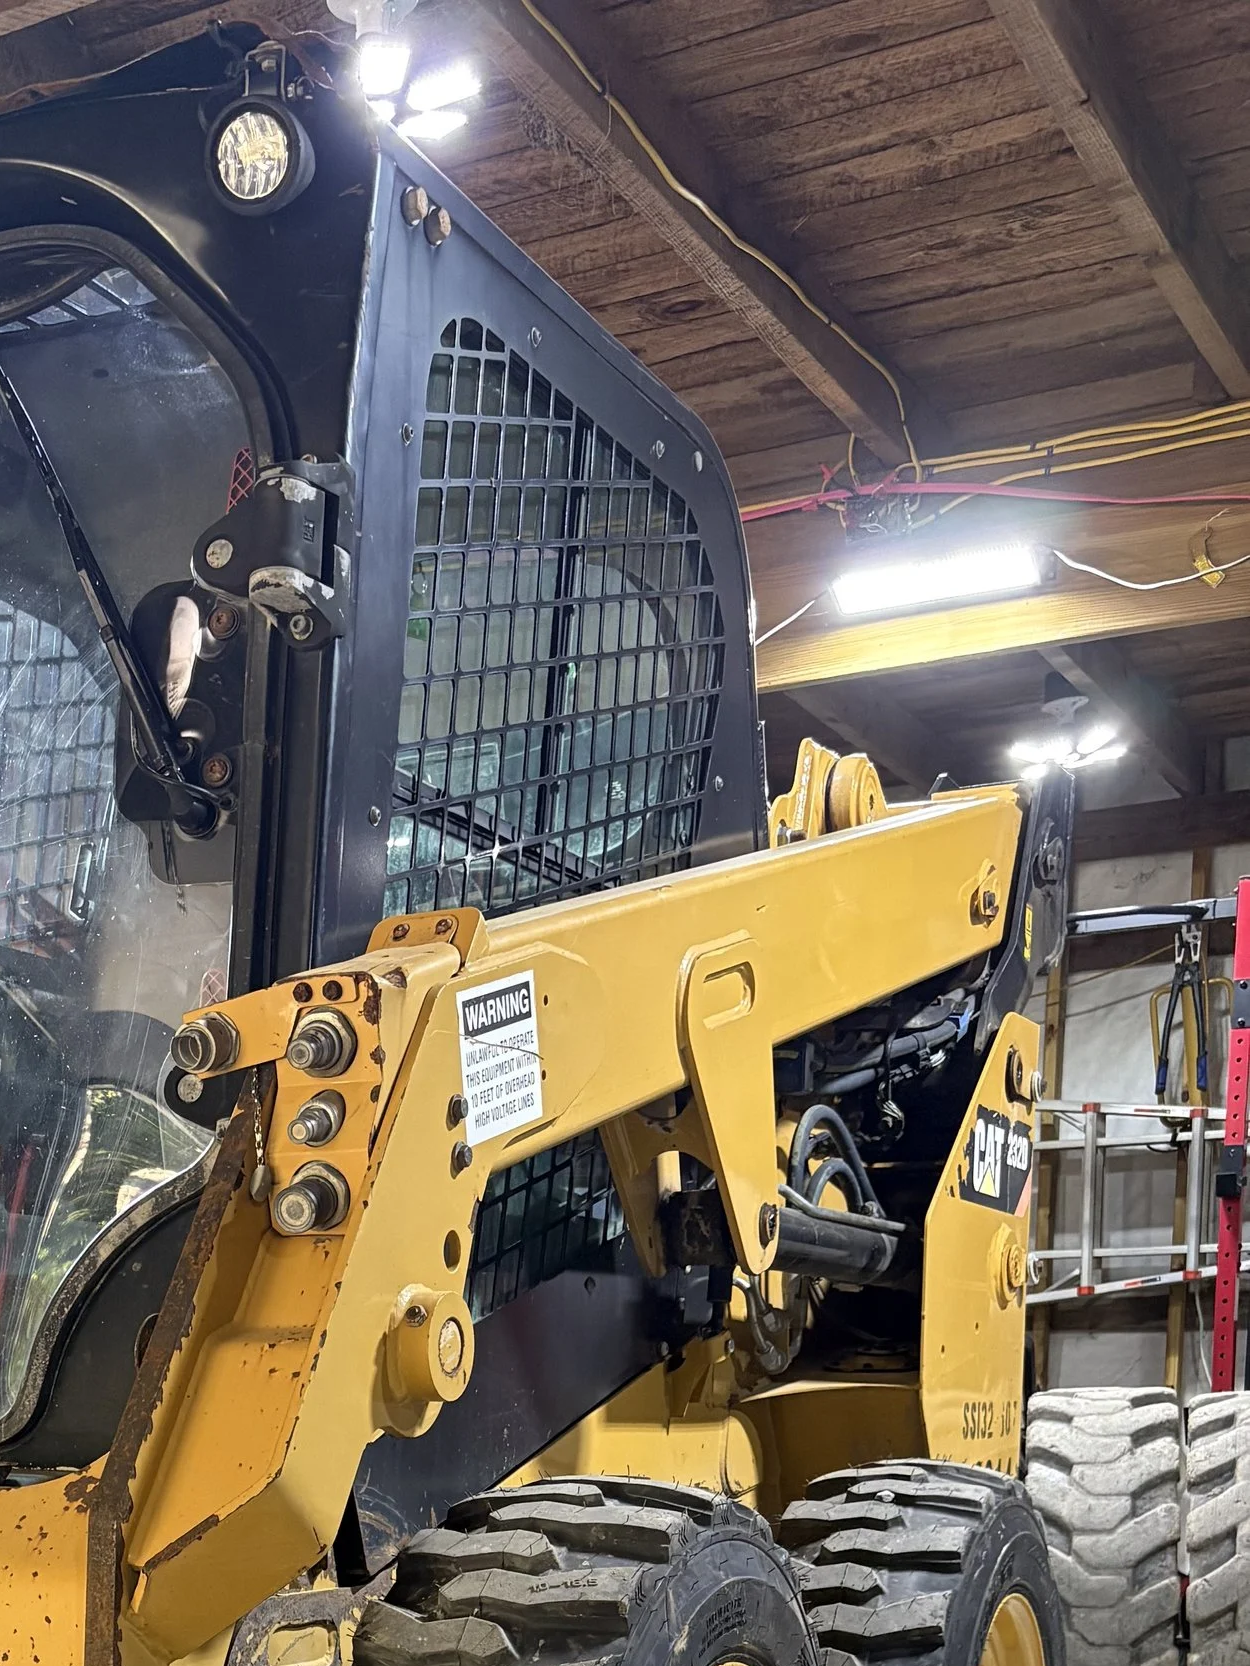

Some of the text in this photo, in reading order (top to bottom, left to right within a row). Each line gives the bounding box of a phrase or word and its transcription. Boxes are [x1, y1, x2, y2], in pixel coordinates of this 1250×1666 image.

[465, 988, 529, 1031] WARNING
[466, 1030, 534, 1067] UNLAWFUL TO OPERATE
[466, 1053, 537, 1088] THIS EQUIPMENT WITHIN
[471, 1071, 535, 1108] 10 FEET OF OVERHEAD
[475, 1092, 534, 1129] HIGH VOLTAGE LINES
[973, 1118, 1029, 1198] CAT 232D
